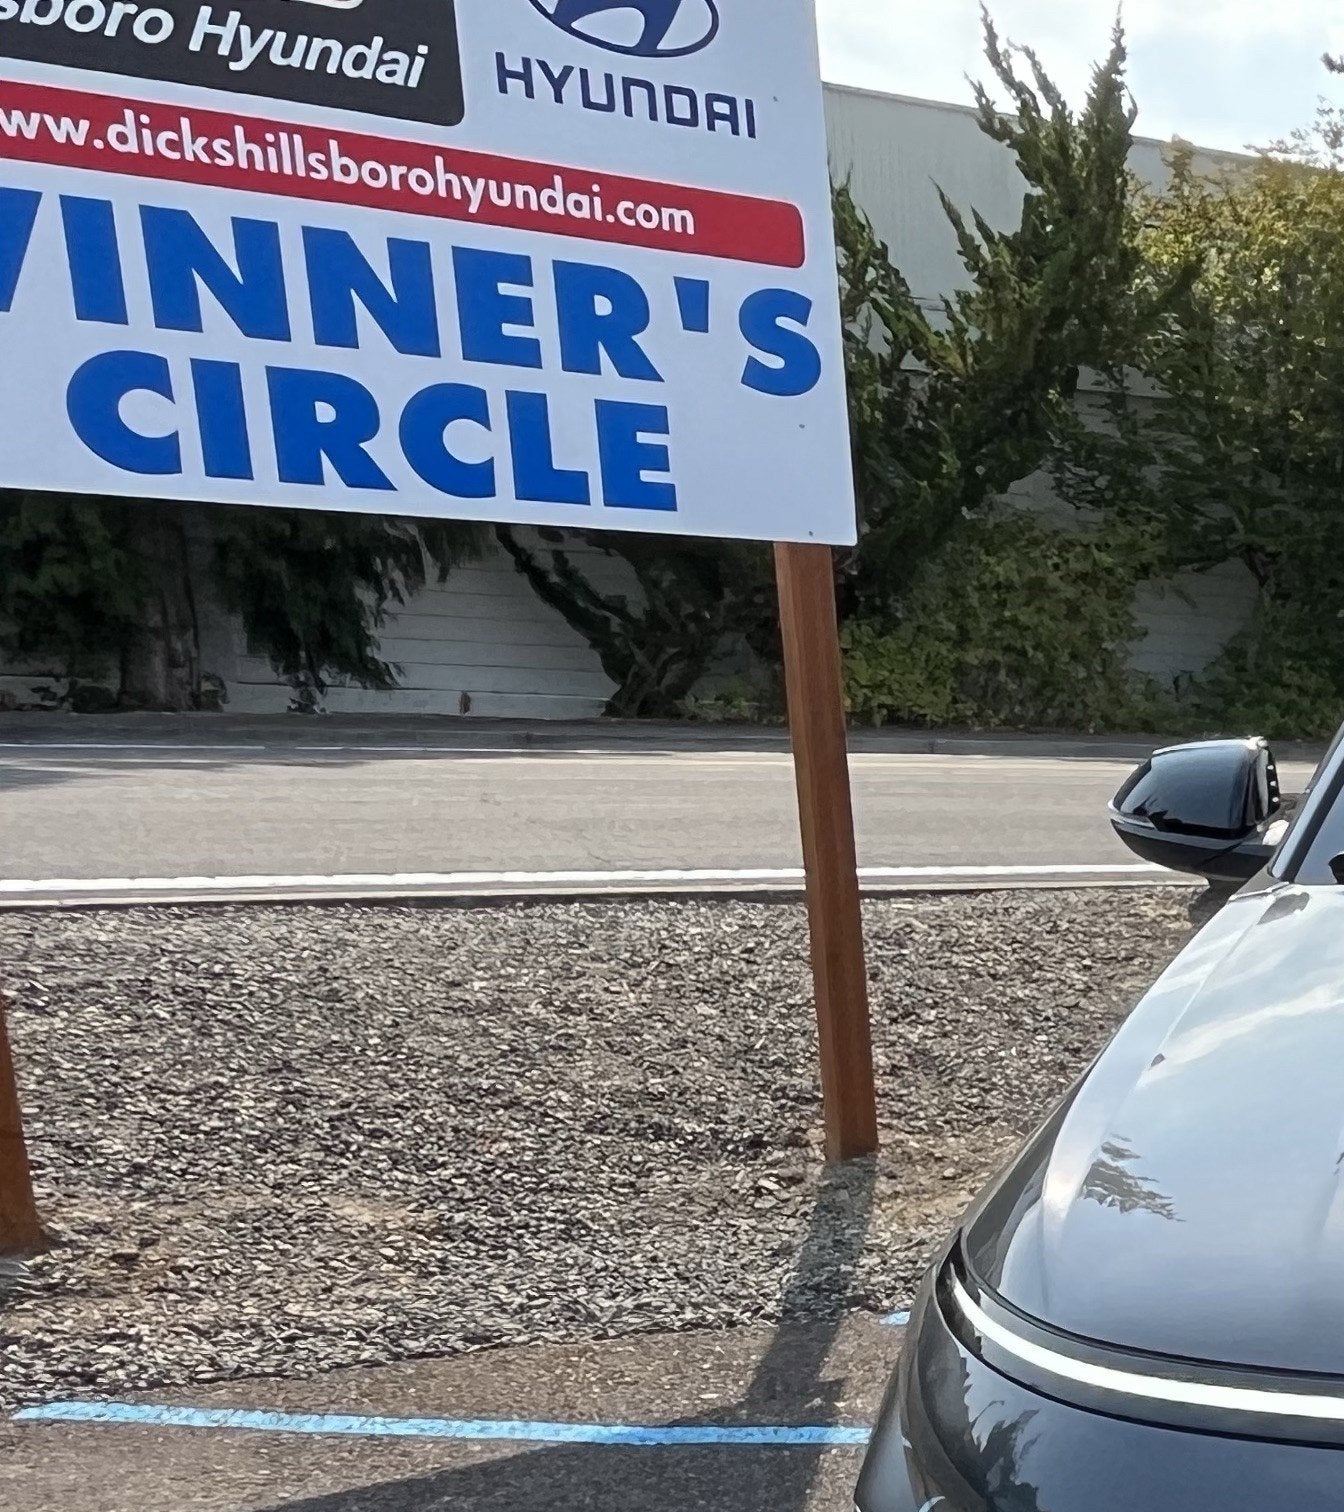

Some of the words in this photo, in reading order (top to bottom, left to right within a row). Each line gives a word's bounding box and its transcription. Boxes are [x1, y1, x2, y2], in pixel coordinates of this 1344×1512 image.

[188, 5, 429, 89] Hyundai
[495, 51, 758, 138] HYUNDAI
[66, 350, 678, 512] CIRCLE
